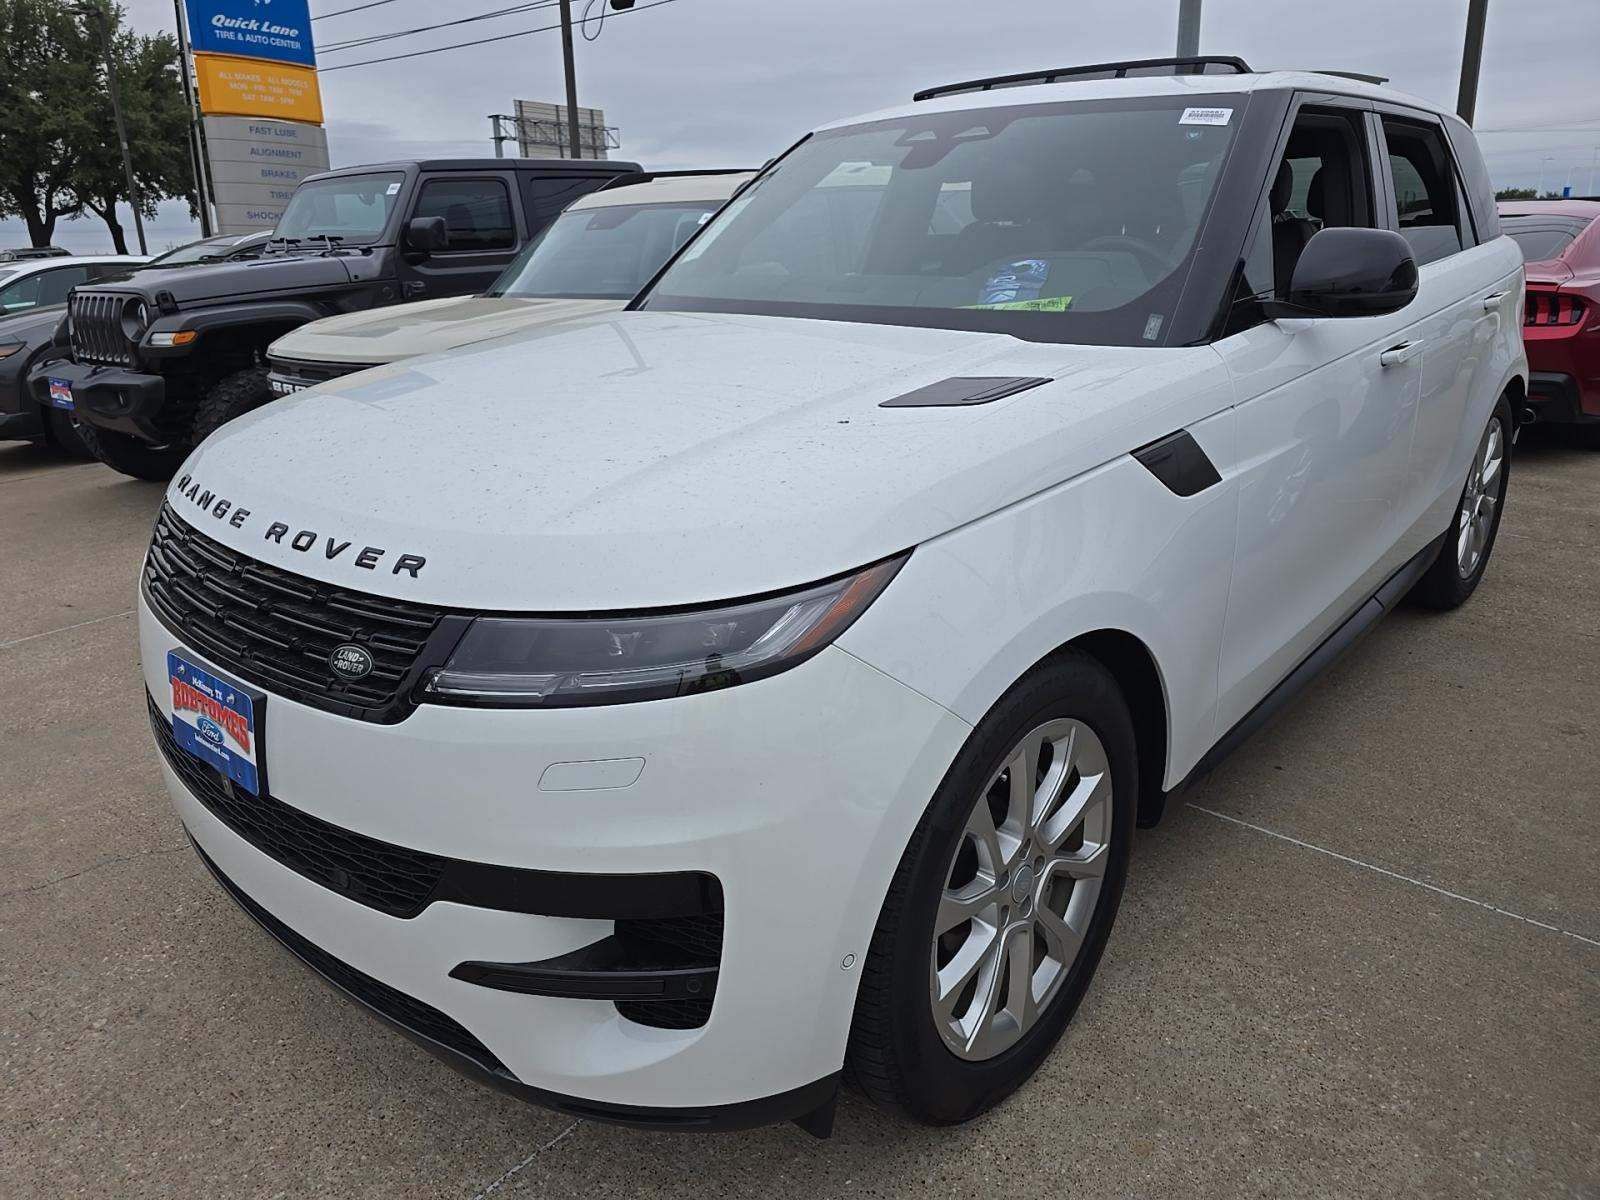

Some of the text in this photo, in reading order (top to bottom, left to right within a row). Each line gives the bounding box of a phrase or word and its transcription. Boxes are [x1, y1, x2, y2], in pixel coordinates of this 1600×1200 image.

[211, 14, 300, 37] Quick Lane
[215, 30, 302, 50] TIRE & AUTO CENTER
[249, 126, 297, 138] FAST LUBE
[250, 147, 302, 160] ALIGNMENT
[261, 169, 298, 180] BRAKES
[178, 473, 427, 578] RANGE ROVER
[337, 649, 360, 662] LAND
[336, 659, 364, 674] ROVER
[201, 720, 220, 740] Ford
